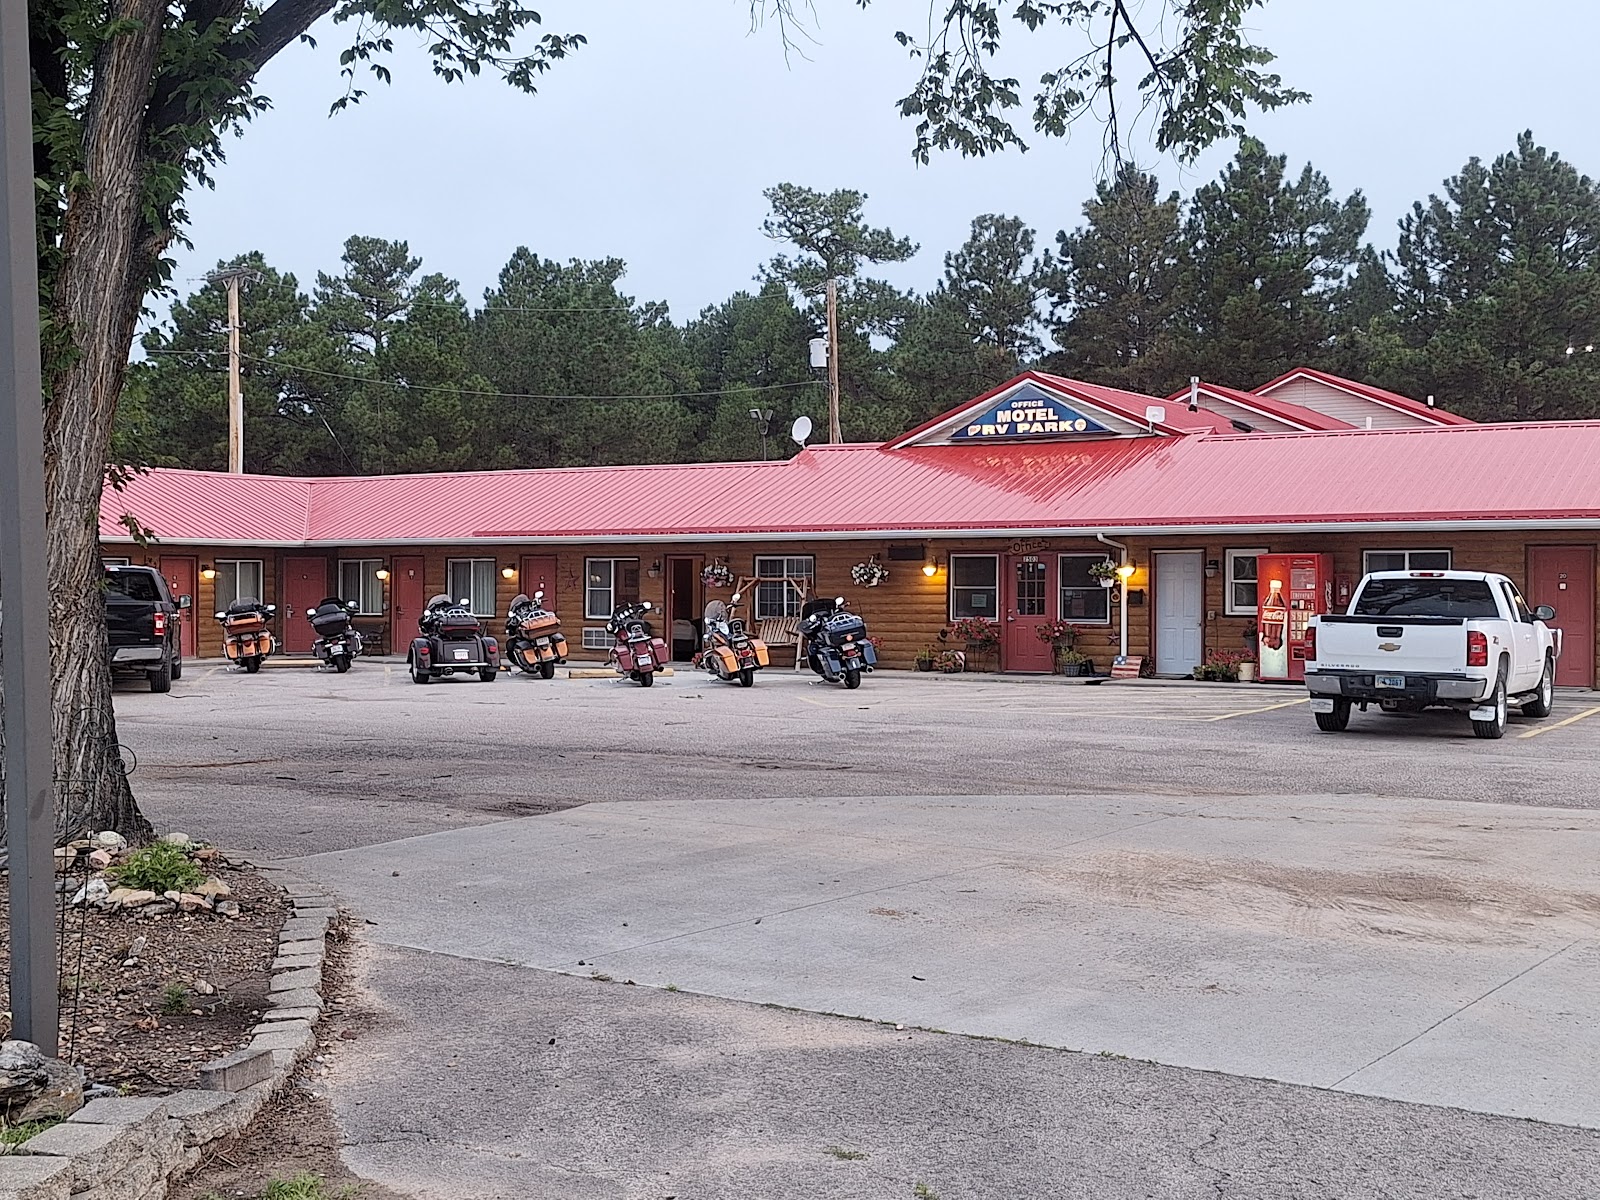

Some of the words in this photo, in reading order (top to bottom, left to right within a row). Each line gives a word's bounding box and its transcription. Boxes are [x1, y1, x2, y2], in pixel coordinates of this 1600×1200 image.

[1011, 400, 1044, 408] OFFICE
[997, 408, 1058, 422] MOTEL
[982, 424, 1009, 435] RV
[1017, 421, 1073, 433] PARK
